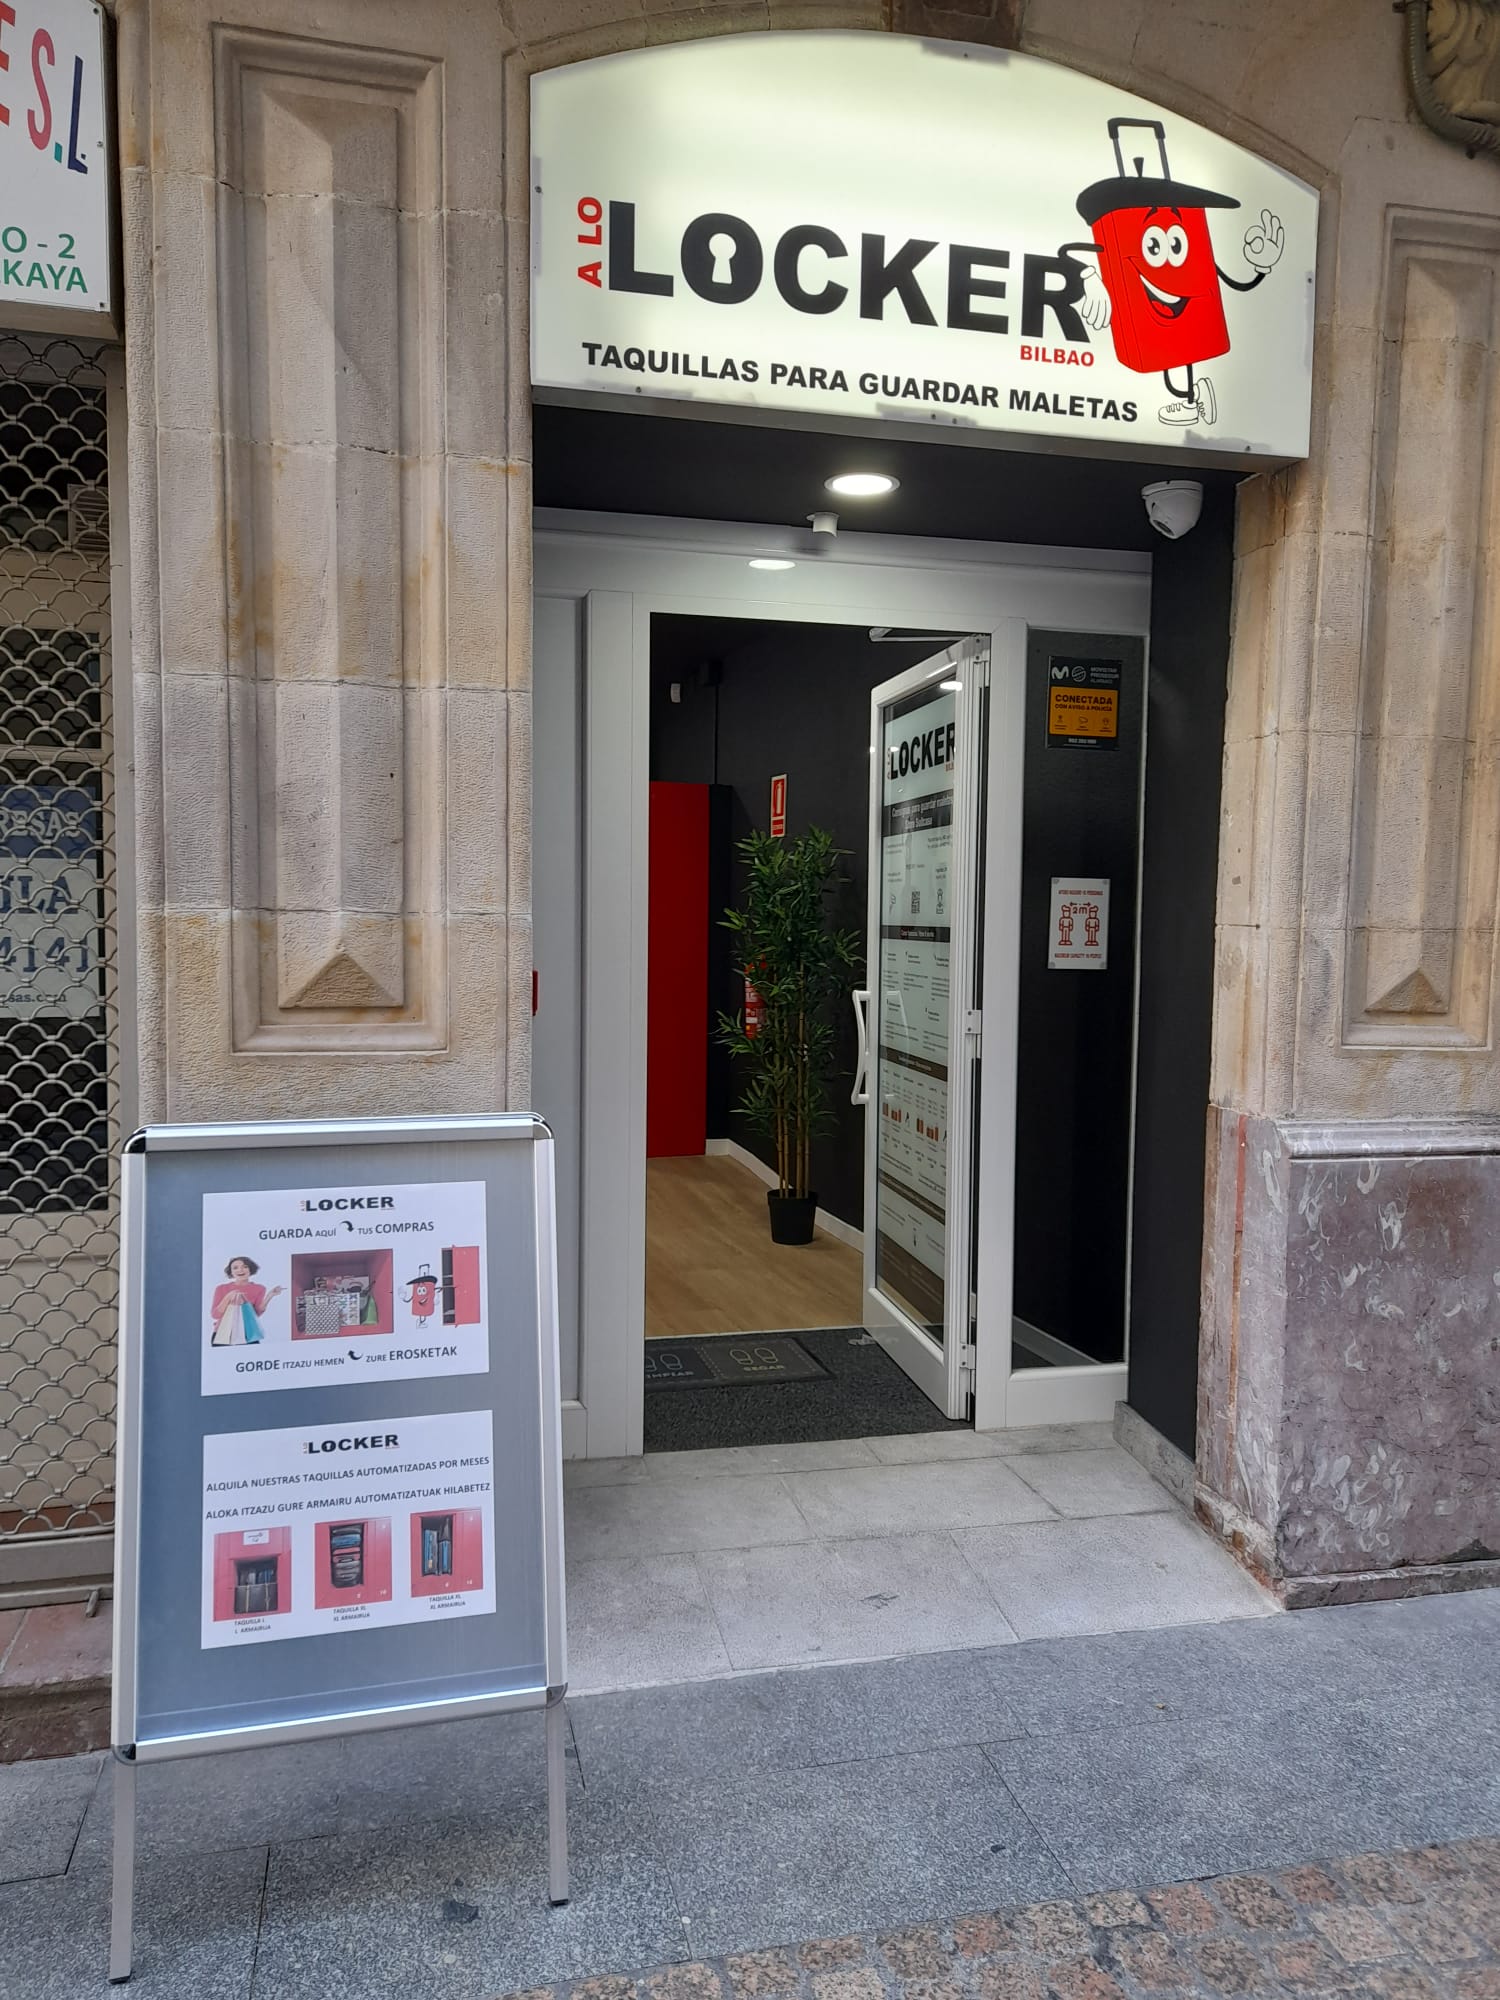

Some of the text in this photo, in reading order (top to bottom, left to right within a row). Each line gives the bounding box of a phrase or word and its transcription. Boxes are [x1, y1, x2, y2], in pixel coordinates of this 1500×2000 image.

[577, 196, 603, 288] A LO
[0, 259, 88, 293] KAYA
[608, 199, 1091, 343] LOCKER
[1020, 345, 1094, 367] BILBAO
[582, 342, 1138, 422] TAQUILLAS PARA GUARDAR MALETAS
[1055, 694, 1113, 705] CONECTADA
[891, 722, 955, 780] LOCKER
[306, 1196, 396, 1212] LOCKER
[259, 1227, 313, 1241] GUARDA
[358, 1227, 373, 1235] TUS
[375, 1221, 434, 1234] COMPRAS
[235, 1346, 457, 1373] GORDE ITZAZU HEMEN ZURE EROSKETAK
[308, 1434, 399, 1454] LOCKER
[206, 1456, 490, 1492] ALQUILA NUESTRAS TAQUILLAS AUTOMATIZADAS POR MESES
[206, 1482, 491, 1520] ALOKA ITZAZU GURE ARMAIRU AUTOMATIZATUAK HILABETEZ
